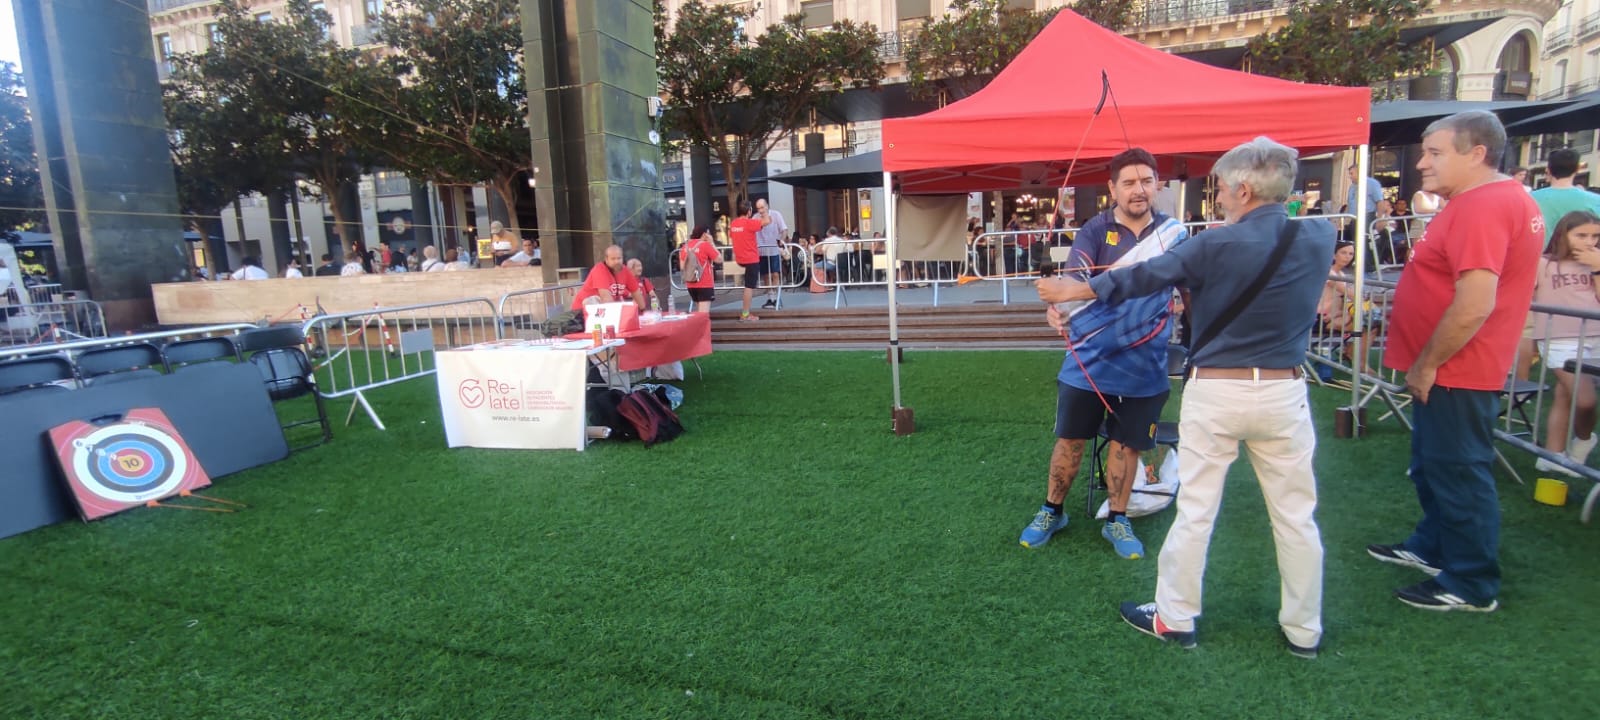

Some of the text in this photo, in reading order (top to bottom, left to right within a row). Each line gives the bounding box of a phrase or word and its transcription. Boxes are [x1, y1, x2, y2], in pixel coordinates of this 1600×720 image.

[487, 379, 517, 395] Re-
[489, 395, 520, 410] late
[124, 458, 139, 468] 10
